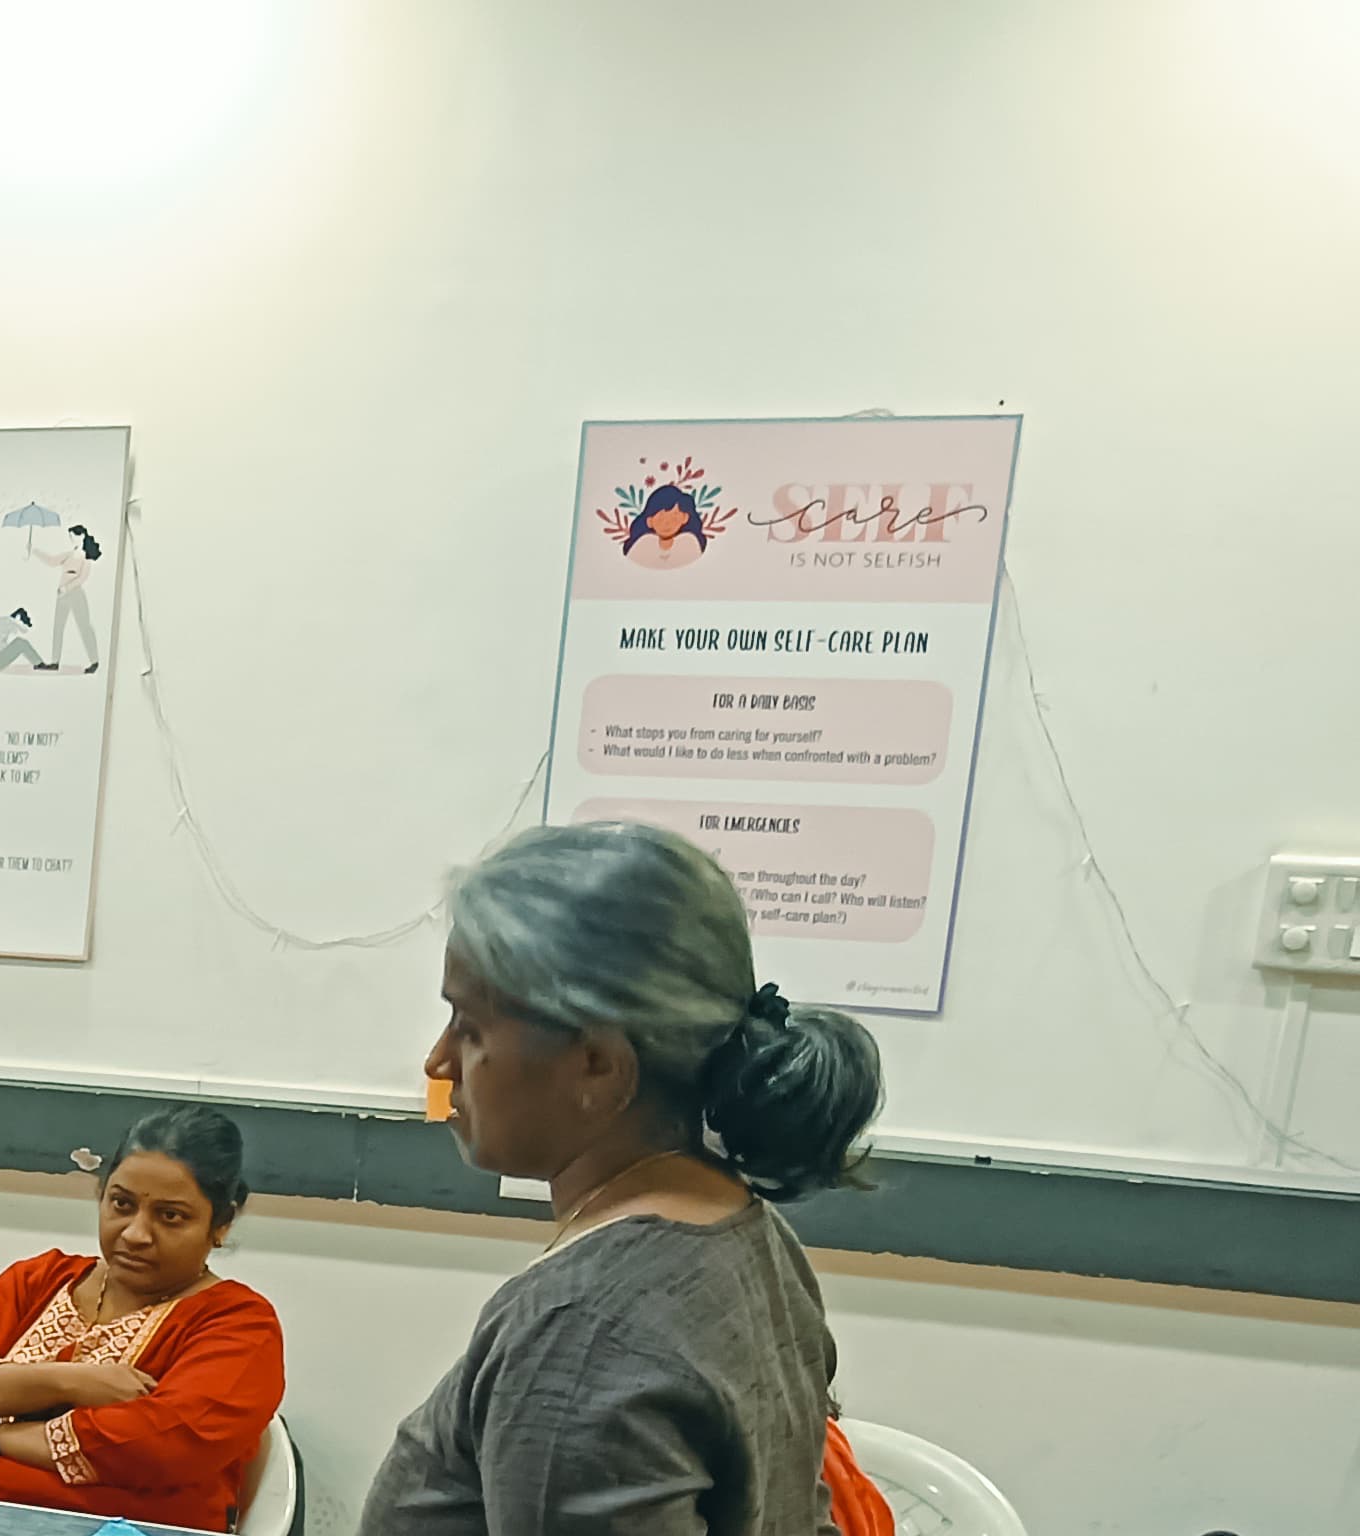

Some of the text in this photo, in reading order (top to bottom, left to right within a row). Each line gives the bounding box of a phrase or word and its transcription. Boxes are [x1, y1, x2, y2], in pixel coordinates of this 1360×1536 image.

[748, 496, 987, 533] care
[767, 483, 974, 543] SELF
[790, 552, 941, 569] IS NOT SELFISH
[619, 628, 929, 653] MAKE YOUR OWN SELF-CARE PLAN
[712, 693, 816, 711] FOR A DAILY BASIS
[606, 725, 823, 744] What stops you from caring for yourself?
[604, 744, 936, 766] What would I like to do less when confronted with a problem?
[700, 815, 800, 833] FOR EMERGENCIES
[758, 870, 816, 885] throughout
[820, 872, 837, 885] the
[840, 874, 866, 888] day?
[782, 892, 801, 901] can
[804, 892, 808, 901] I
[811, 892, 837, 904] call?
[840, 893, 864, 906] Who
[867, 894, 886, 907] will
[890, 895, 927, 909] listen?
[761, 909, 847, 924] self-care plan?)
